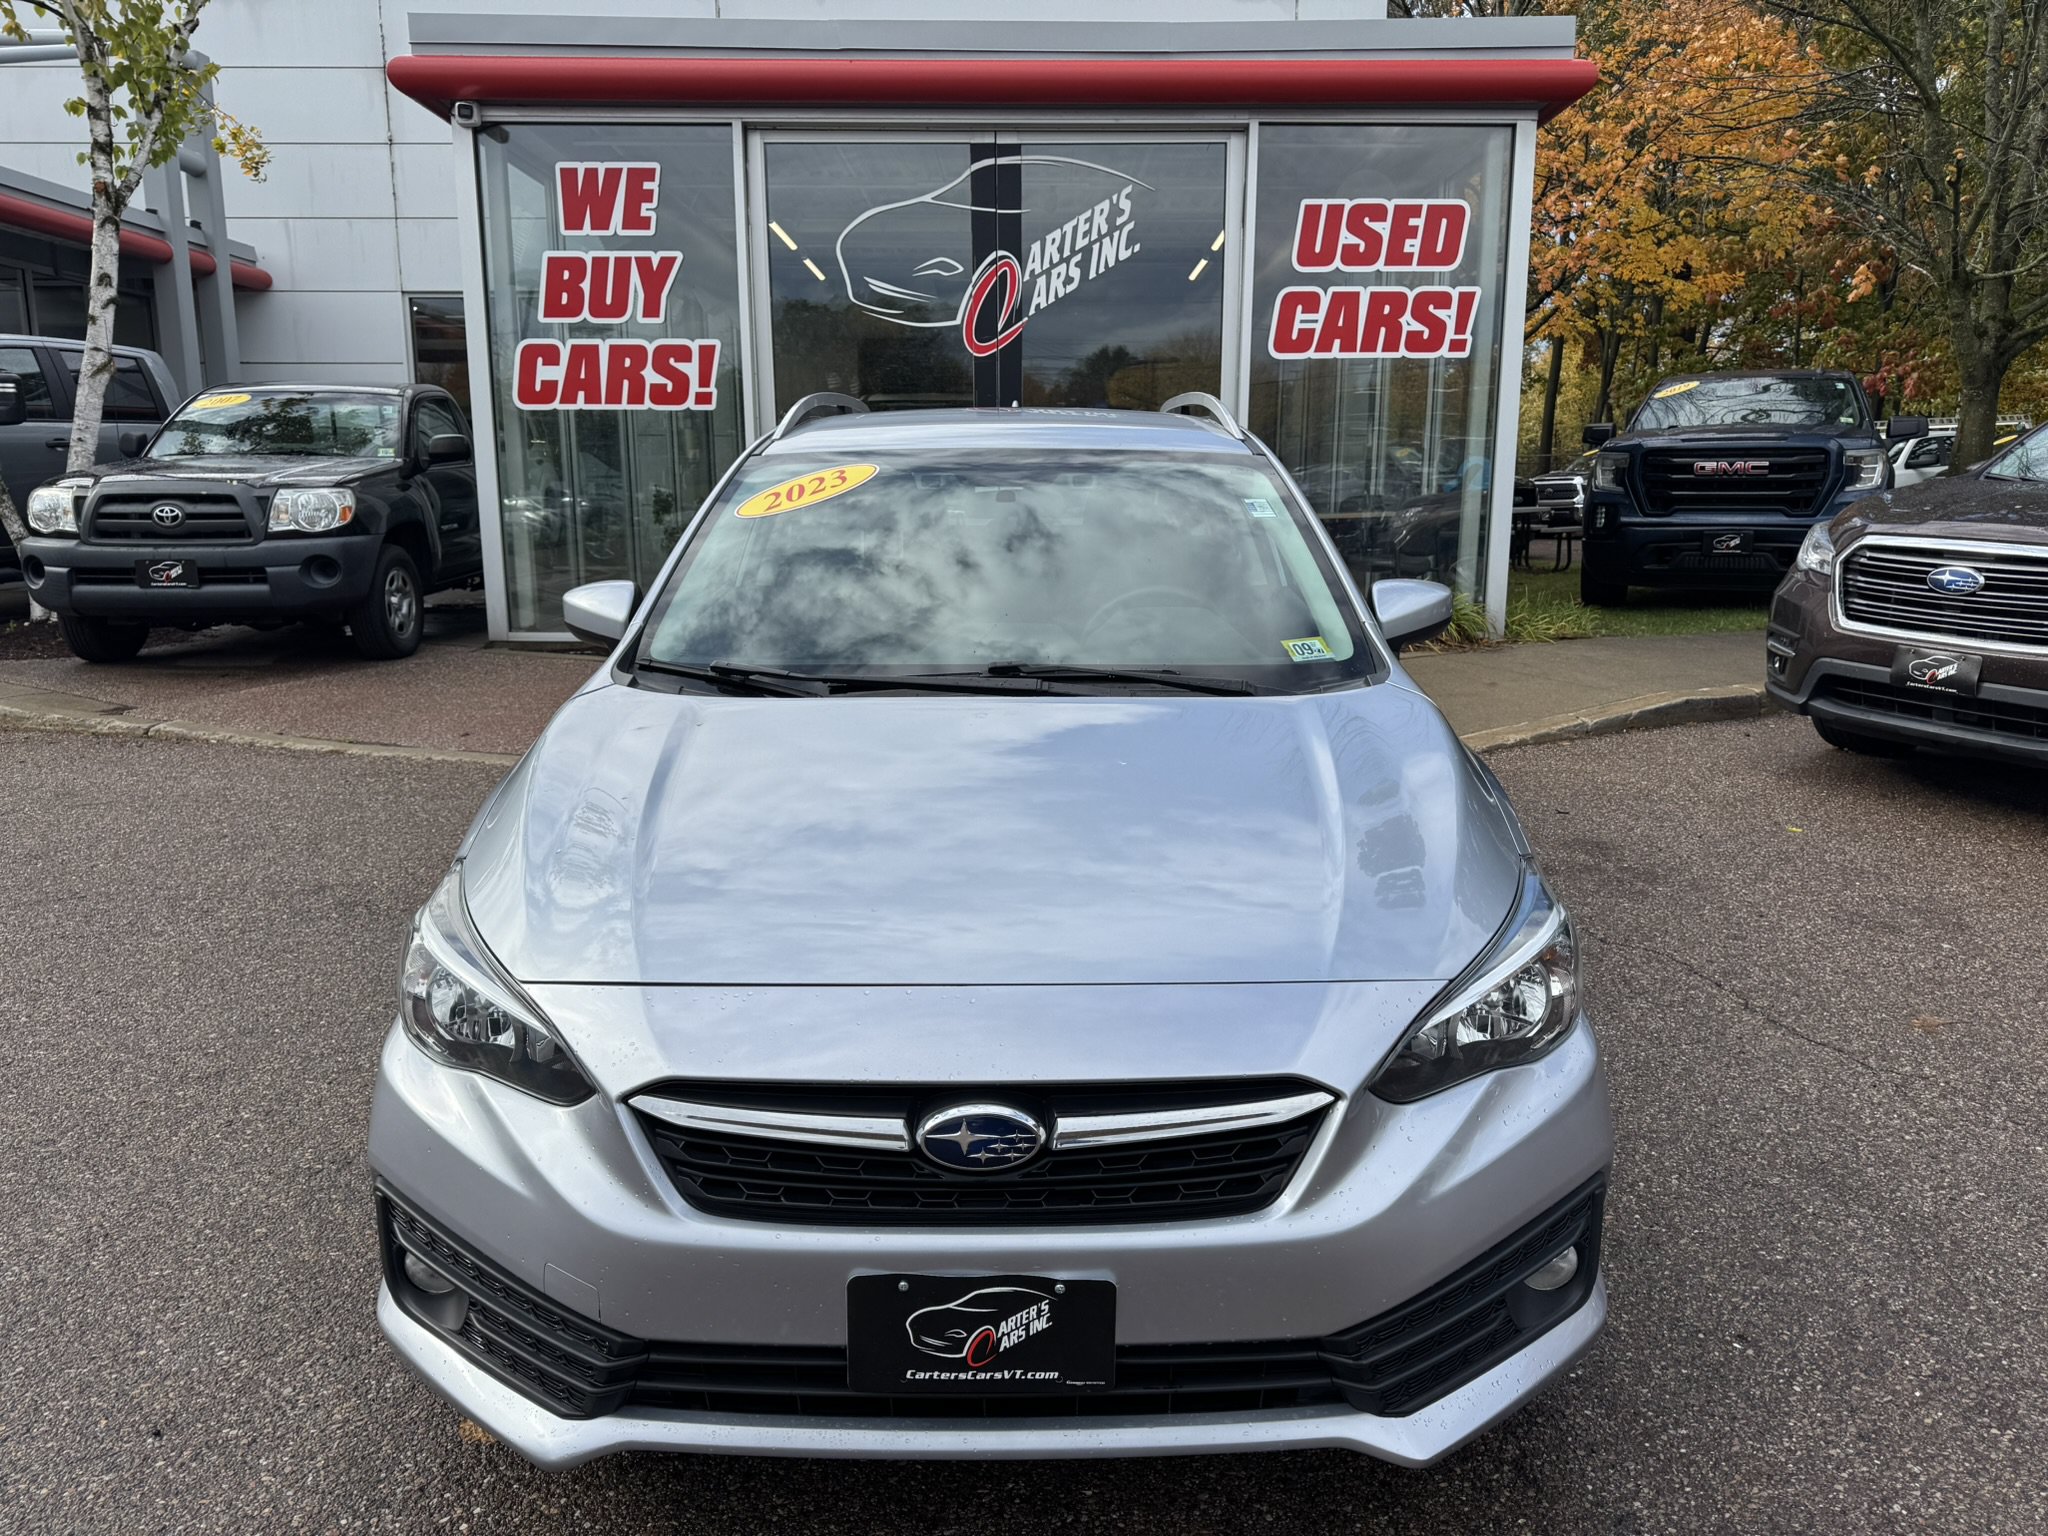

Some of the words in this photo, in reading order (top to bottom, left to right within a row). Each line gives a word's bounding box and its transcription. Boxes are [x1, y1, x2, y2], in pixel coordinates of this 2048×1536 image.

[556, 162, 661, 236] WE
[1089, 220, 1141, 280] INC.
[1291, 198, 1471, 272] USED
[538, 251, 683, 324] BUY
[1268, 286, 1482, 360] CARS!
[512, 339, 721, 411] CARS!
[763, 469, 848, 512] 2023
[1693, 461, 1770, 475] GMC
[1292, 643, 1314, 656] 09
[905, 1369, 1060, 1381] CartersCarsVT.com
